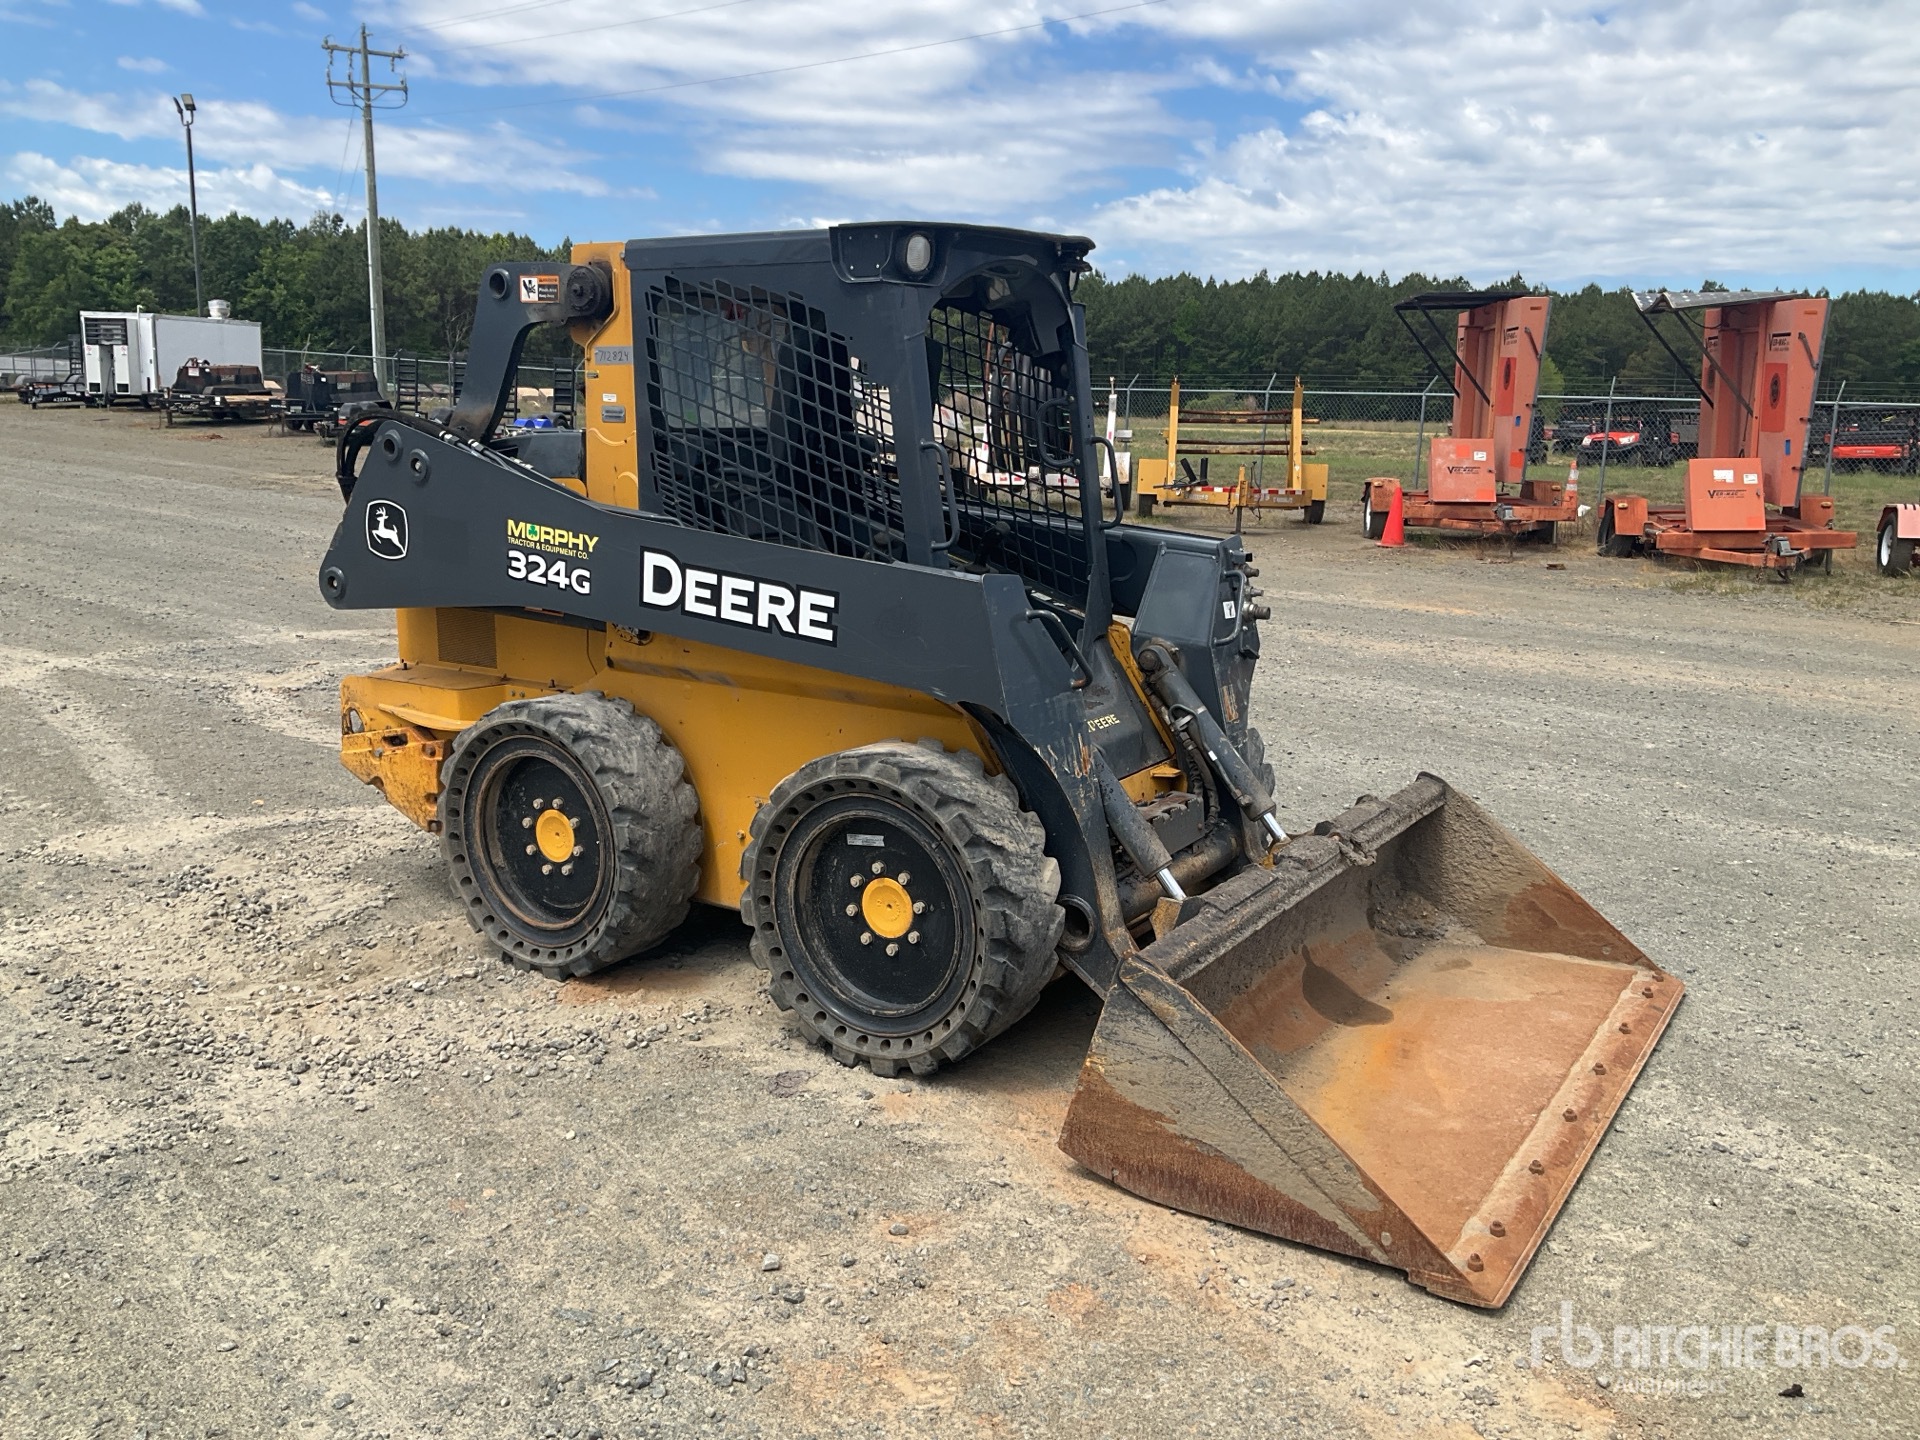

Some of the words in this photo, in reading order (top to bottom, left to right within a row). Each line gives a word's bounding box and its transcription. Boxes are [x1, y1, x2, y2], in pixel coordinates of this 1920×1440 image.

[598, 349, 630, 362] 712824
[507, 518, 600, 552] MURPHY
[507, 536, 535, 549] TRACTOR
[536, 542, 541, 550] &
[541, 544, 577, 558] EQUIPMENT
[577, 551, 590, 560] CO.
[507, 549, 592, 595] 324G
[642, 550, 836, 642] DEERE
